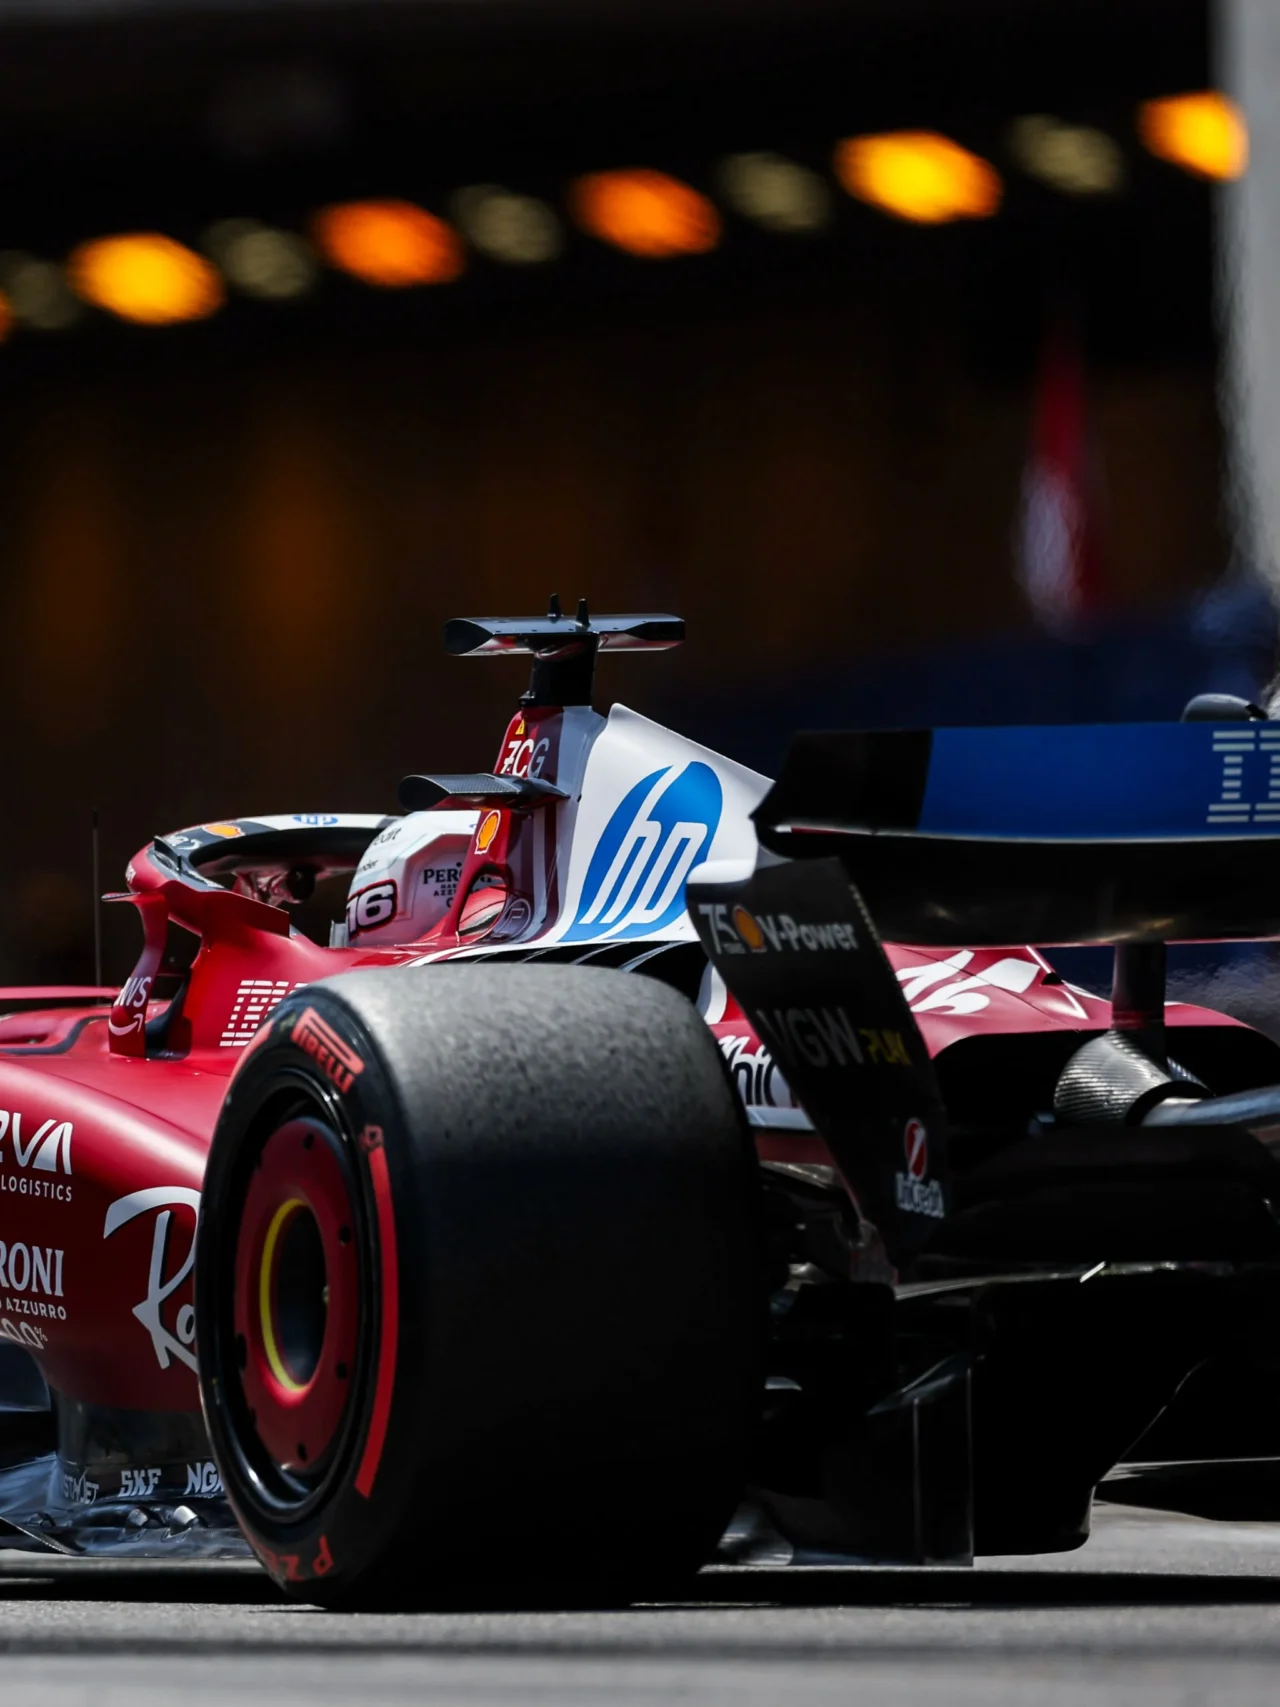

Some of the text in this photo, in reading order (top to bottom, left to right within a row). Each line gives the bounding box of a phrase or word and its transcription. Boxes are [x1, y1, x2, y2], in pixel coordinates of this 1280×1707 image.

[346, 882, 397, 937] 16
[755, 913, 859, 951] V-Power
[756, 1006, 865, 1068] VGW
[1, 1174, 73, 1203] LOGISTICS
[6, 1297, 67, 1320] AZZURRO
[117, 1468, 162, 1497] SKF
